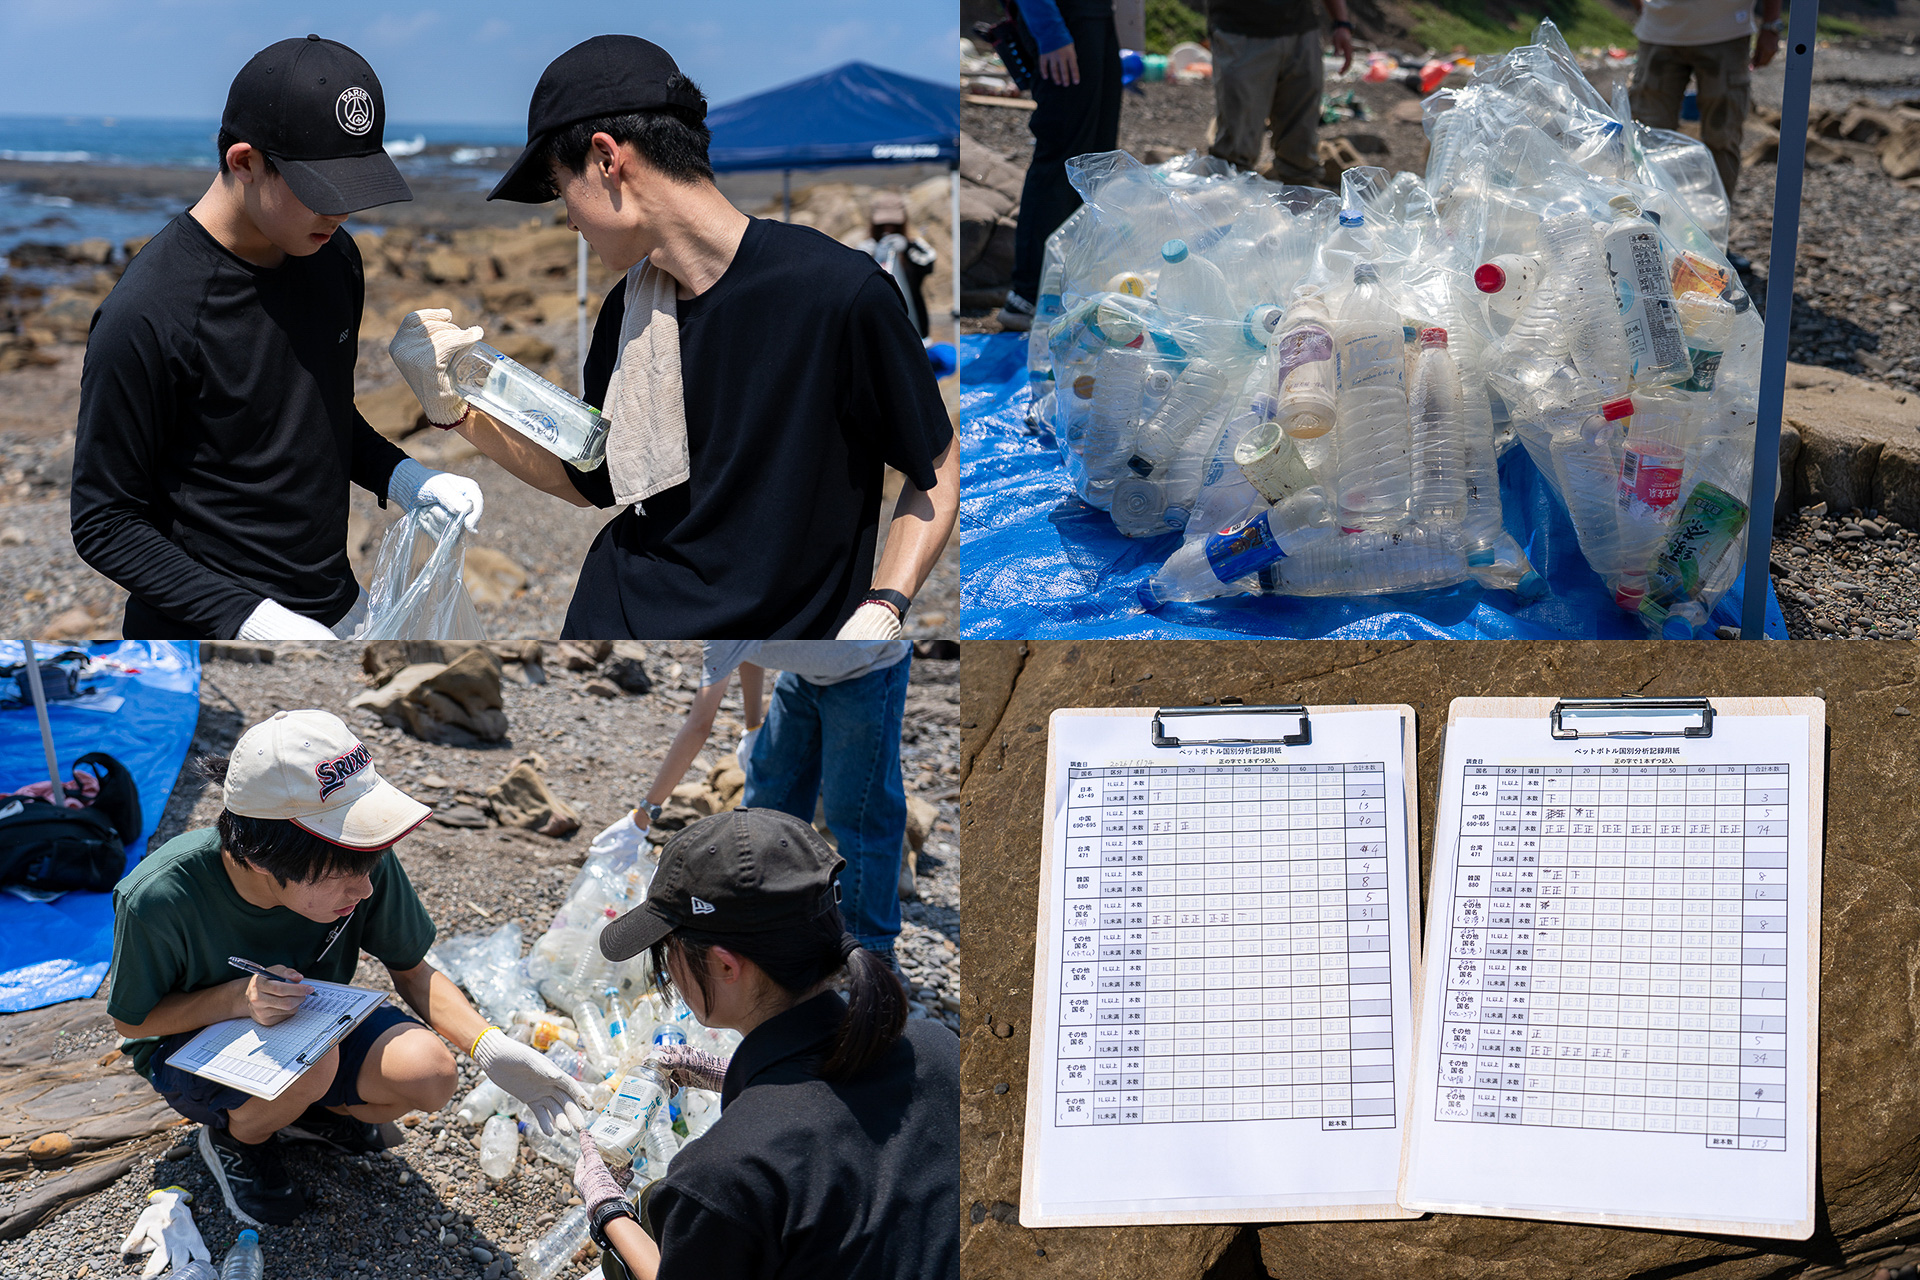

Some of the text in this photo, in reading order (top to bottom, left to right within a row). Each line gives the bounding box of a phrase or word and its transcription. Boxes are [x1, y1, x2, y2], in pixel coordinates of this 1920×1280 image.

[342, 90, 368, 102] PARIS
[1179, 747, 1282, 756] ペットボトル国別分析記録用紙
[1574, 747, 1681, 755] ペットボトル国別分析記録用紙
[316, 744, 372, 787] SRIXON
[1761, 794, 1769, 802] 3
[1764, 809, 1772, 818] 5
[1362, 876, 1369, 887] 8
[1366, 892, 1376, 902] 5
[1362, 907, 1373, 918] 31
[1752, 1053, 1768, 1064] 34
